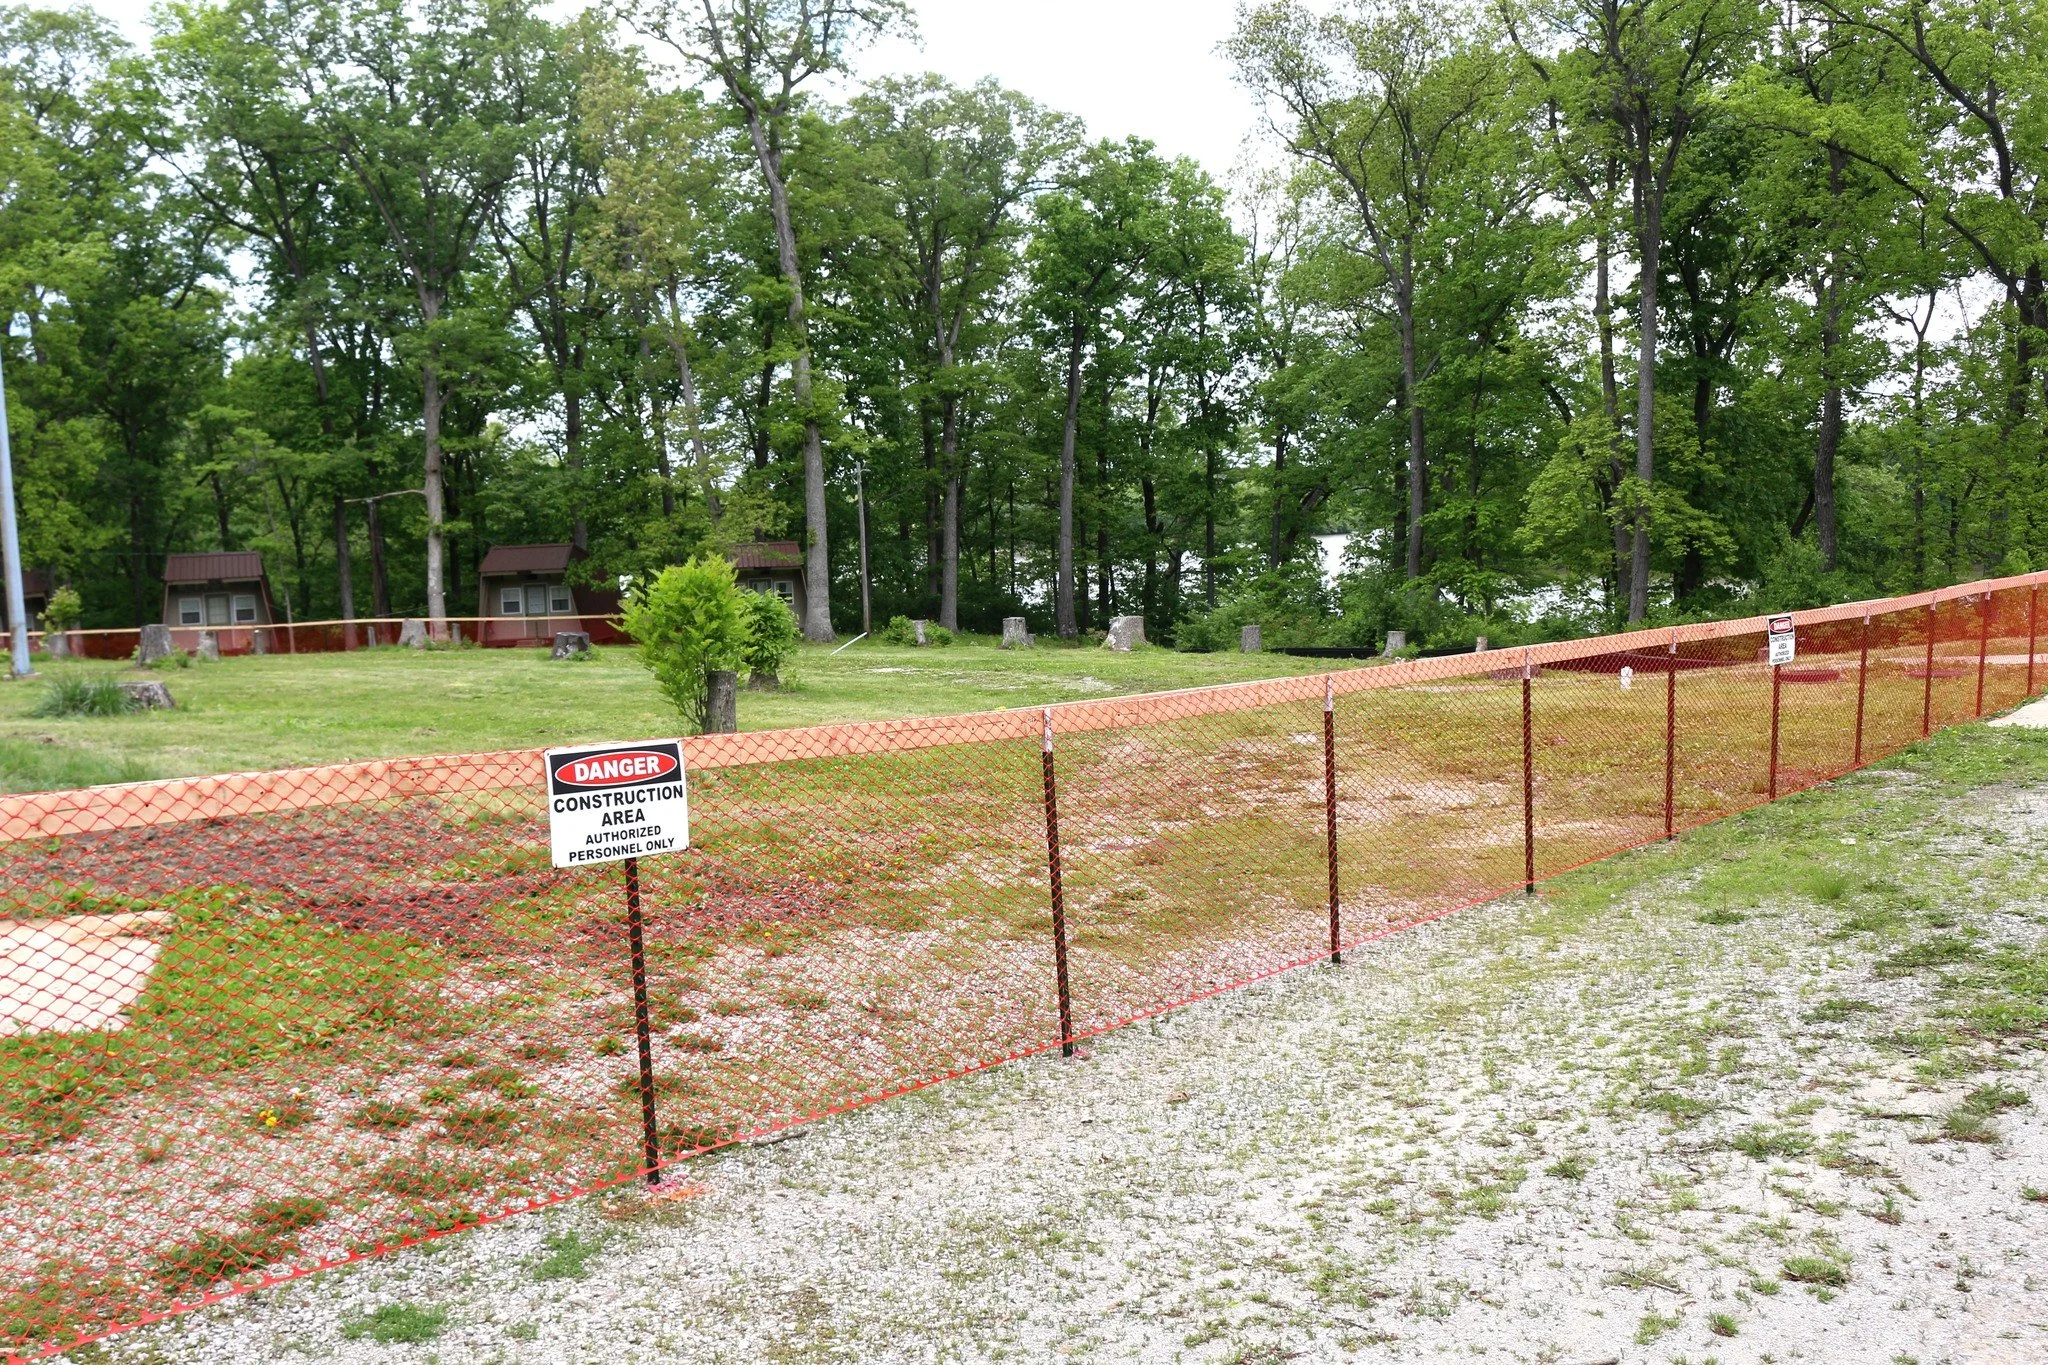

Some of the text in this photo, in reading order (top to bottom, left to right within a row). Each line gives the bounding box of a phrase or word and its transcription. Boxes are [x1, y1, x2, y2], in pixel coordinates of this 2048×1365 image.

[573, 755, 661, 782] DANGER
[554, 784, 683, 813] CONSTRUCTION
[601, 808, 645, 827] AREA
[585, 825, 661, 845] AUTHORIZED
[569, 837, 675, 862] PERSONNEL ONLY
